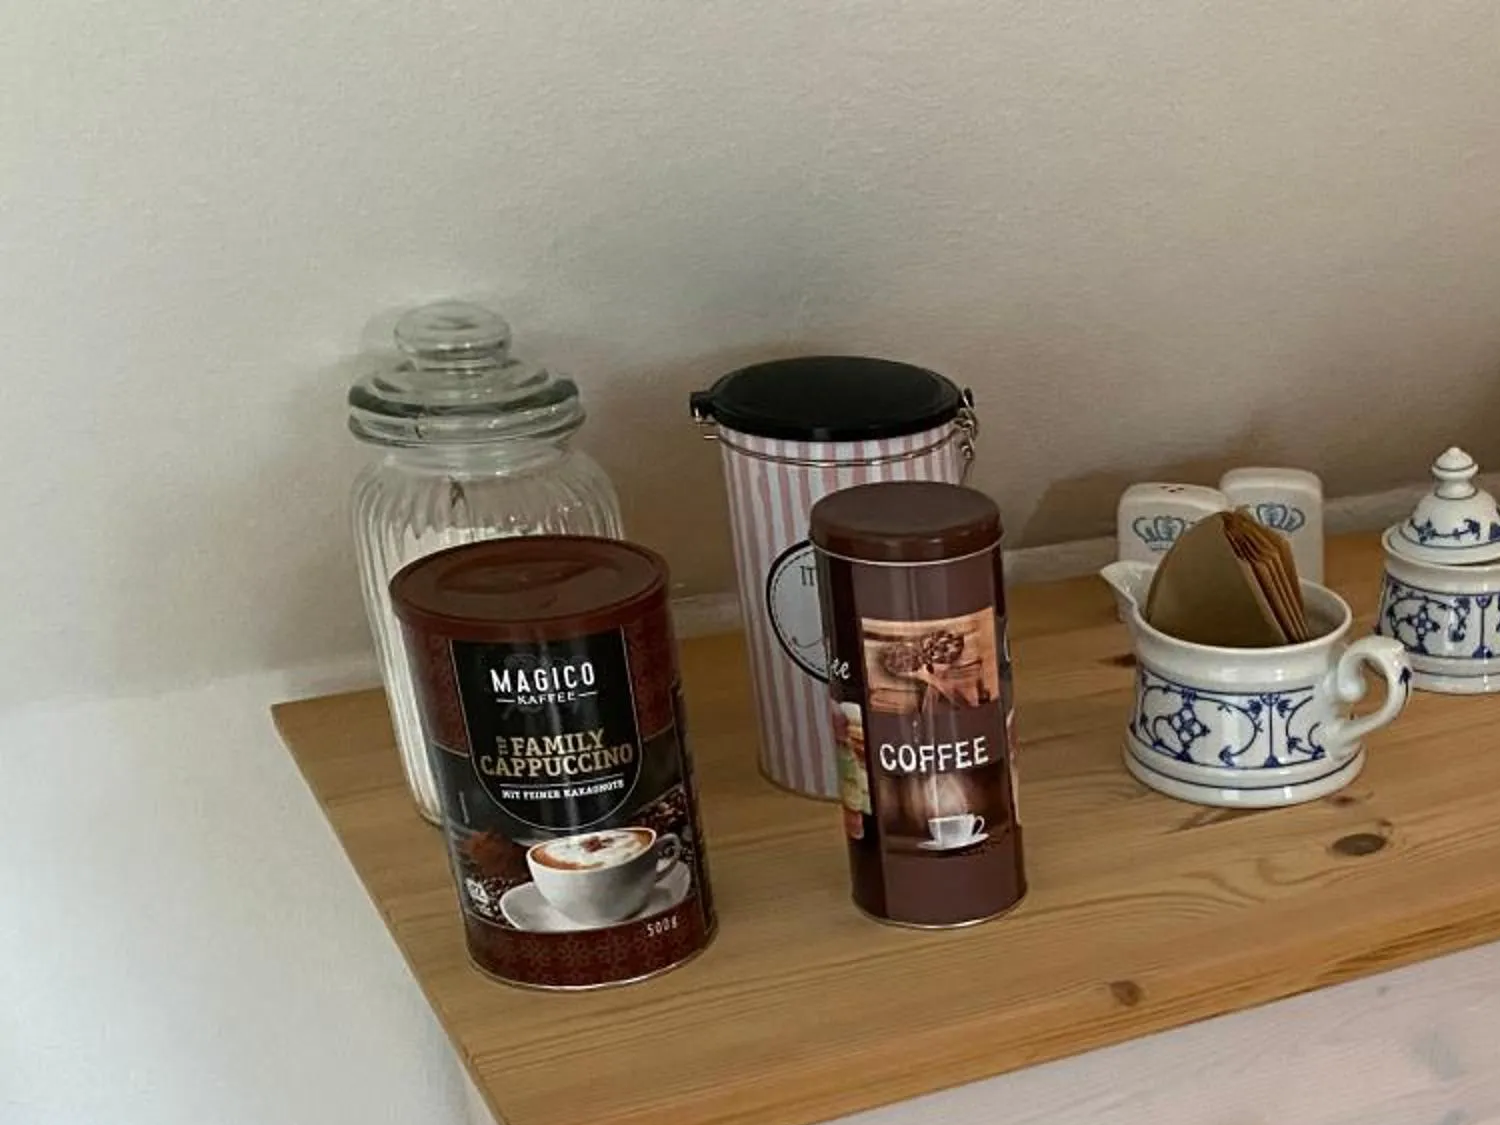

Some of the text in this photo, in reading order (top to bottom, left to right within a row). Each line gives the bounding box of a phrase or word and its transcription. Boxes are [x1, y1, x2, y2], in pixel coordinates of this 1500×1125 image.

[489, 662, 596, 693] MAGICO
[517, 691, 577, 705] KAFFEE
[510, 727, 605, 757] FAMILY
[880, 736, 989, 772] COFFEE
[480, 743, 633, 777] CAPPUCCINO
